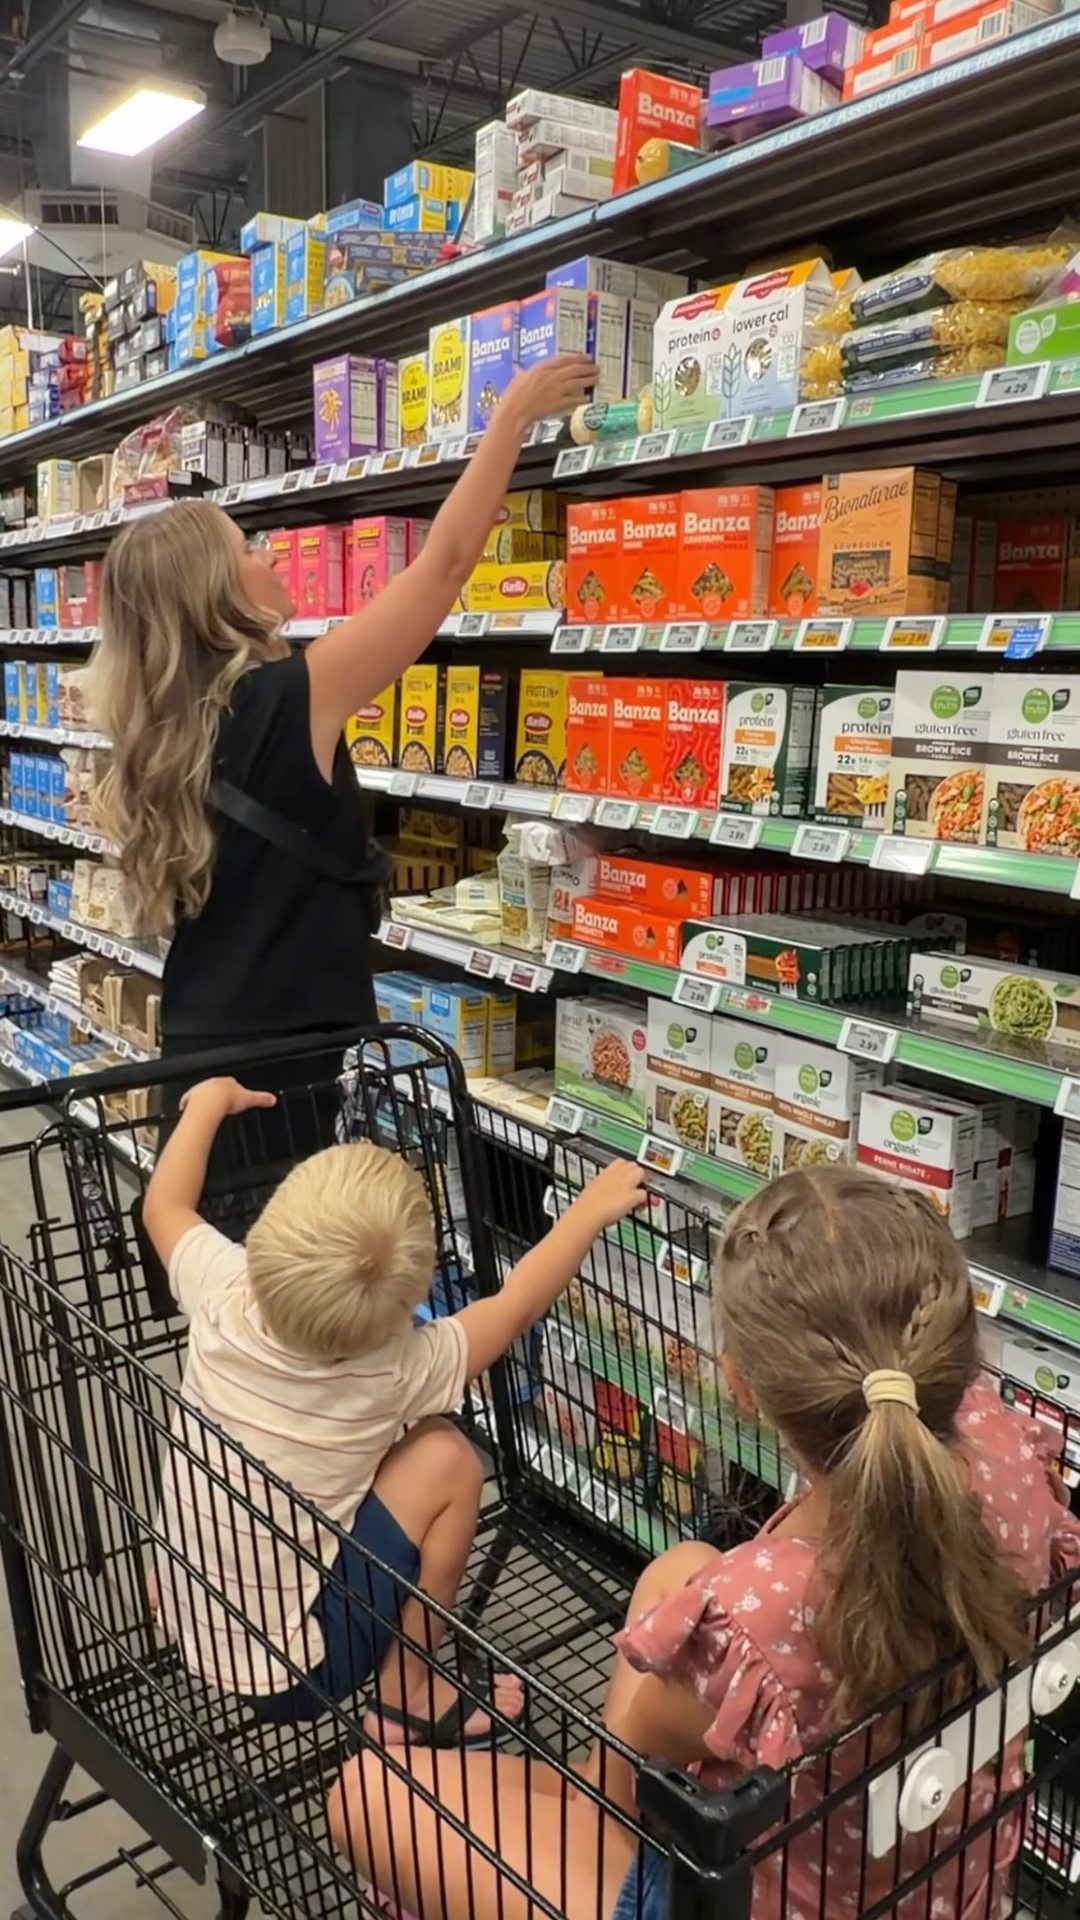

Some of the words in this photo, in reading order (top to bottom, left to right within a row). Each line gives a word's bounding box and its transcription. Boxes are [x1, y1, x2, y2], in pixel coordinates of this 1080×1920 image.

[638, 91, 697, 130] Banza
[836, 79, 924, 124] Assistance
[733, 314, 767, 334] lower
[769, 303, 790, 324] cal
[519, 322, 555, 348] Banza
[668, 327, 711, 354] protein
[471, 337, 510, 359] Banza
[433, 356, 462, 378] BRAMI
[402, 386, 427, 405] BRAMI
[1004, 383, 1028, 395] 4.29
[823, 481, 909, 524] Bionaturae
[623, 519, 677, 540] Banza
[684, 512, 751, 533] Banza
[776, 511, 821, 533] Banz
[569, 526, 616, 545] Banza
[1000, 542, 1060, 560] Banza
[569, 696, 608, 717] Banza
[614, 698, 662, 721] Banza
[667, 700, 720, 724] Banza
[740, 714, 774, 727] protein
[841, 722, 892, 735] protein
[914, 722, 953, 736] gluten
[953, 723, 978, 737] free
[1042, 729, 1066, 742] free
[915, 744, 950, 754] BROWN
[950, 747, 972, 756] RICE
[1007, 751, 1039, 761] BROWN
[1039, 754, 1060, 764] RICE
[600, 860, 647, 888] Banza
[552, 888, 570, 913] 21
[575, 903, 618, 934] Banza
[859, 1039, 878, 1051] 2.99
[883, 1139, 921, 1157] organic
[873, 1154, 898, 1166] PENNE
